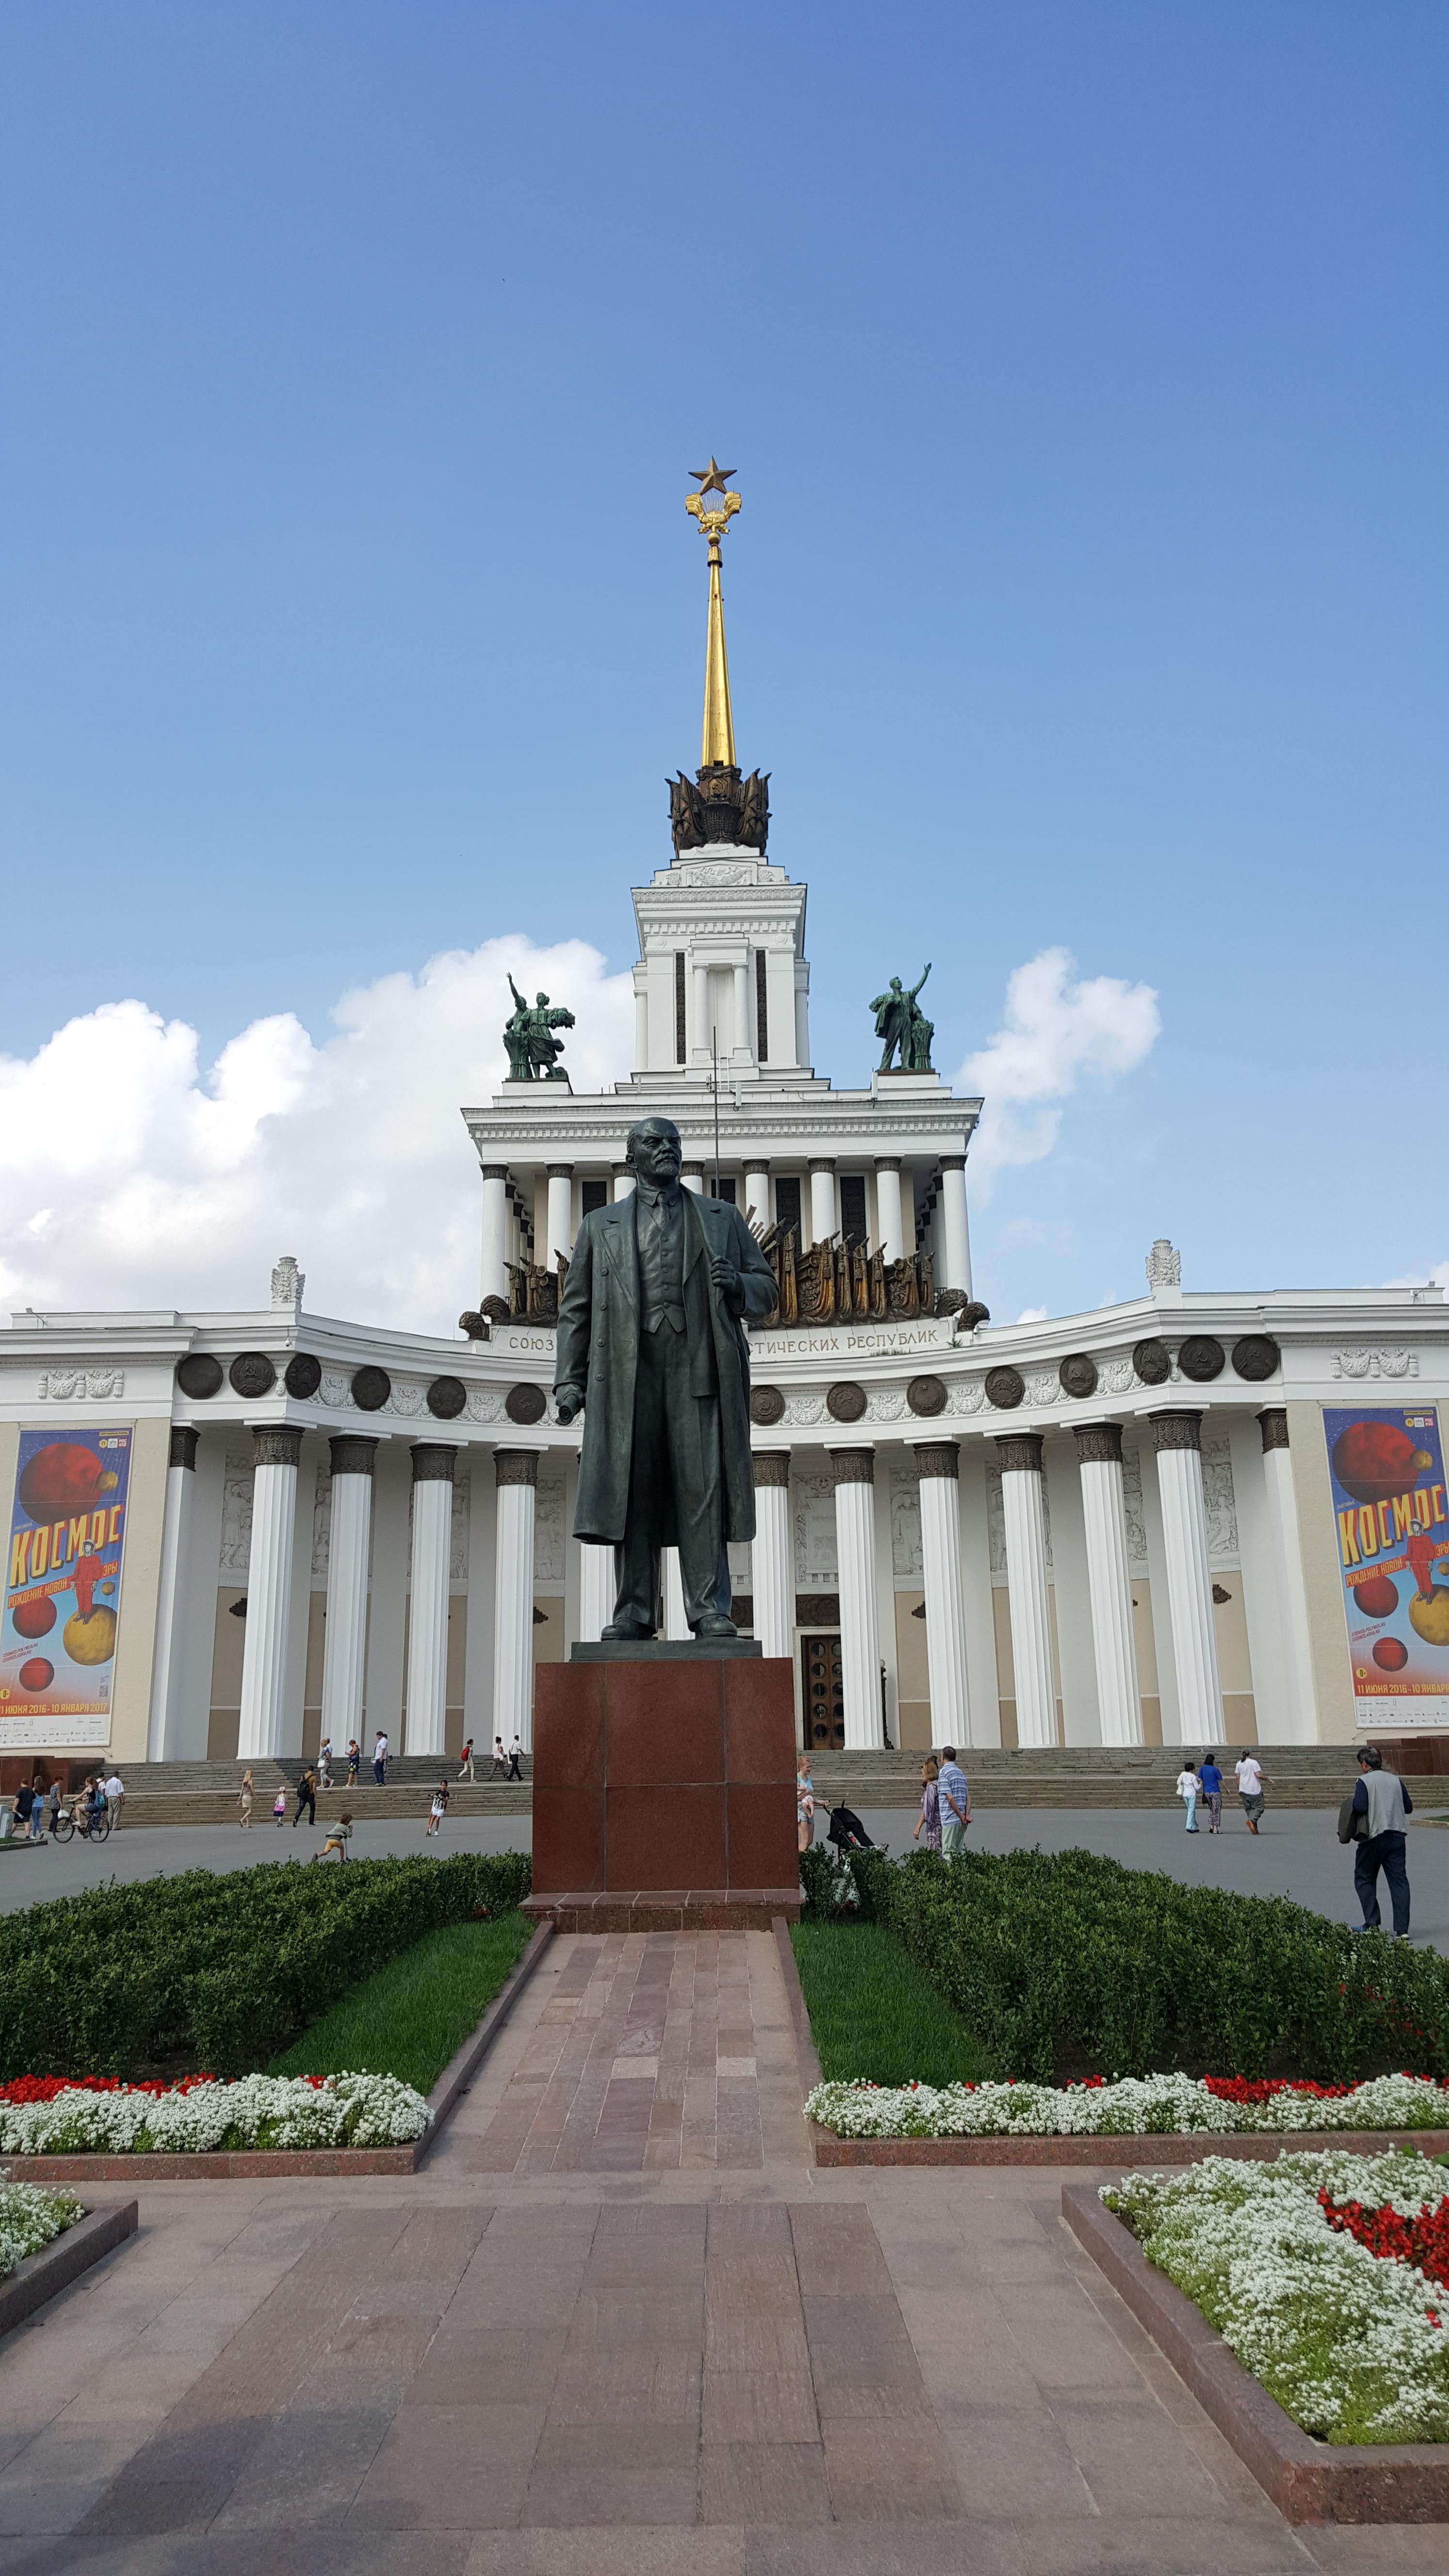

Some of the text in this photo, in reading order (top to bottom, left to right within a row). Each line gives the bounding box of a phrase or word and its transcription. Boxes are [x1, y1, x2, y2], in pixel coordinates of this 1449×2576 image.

[510, 1337, 554, 1351] СОЮЗ
[847, 1330, 938, 1349] РЕСПУБЛИК
[1338, 1484, 1447, 1567] КОСМОС
[9, 1505, 123, 1589] КОСМОС
[9, 1561, 118, 1607] РОЖДЕНИЕ НОВОЙ ЭРЫ
[1346, 1566, 1379, 1586] РОЖДЕНИЕ
[1381, 1557, 1402, 1574] НОВОЙ
[1357, 1685, 1364, 1693] 11
[1365, 1684, 1388, 1693] ИЮНЯ
[1389, 1684, 1407, 1693] 2016
[1412, 1684, 1420, 1693] 10
[5, 1705, 28, 1714] ИЮНЯ
[29, 1704, 47, 1714] 2016
[51, 1704, 59, 1713] 10
[60, 1703, 89, 1713] ЯНВАРЯ
[91, 1703, 107, 1712] 2017
